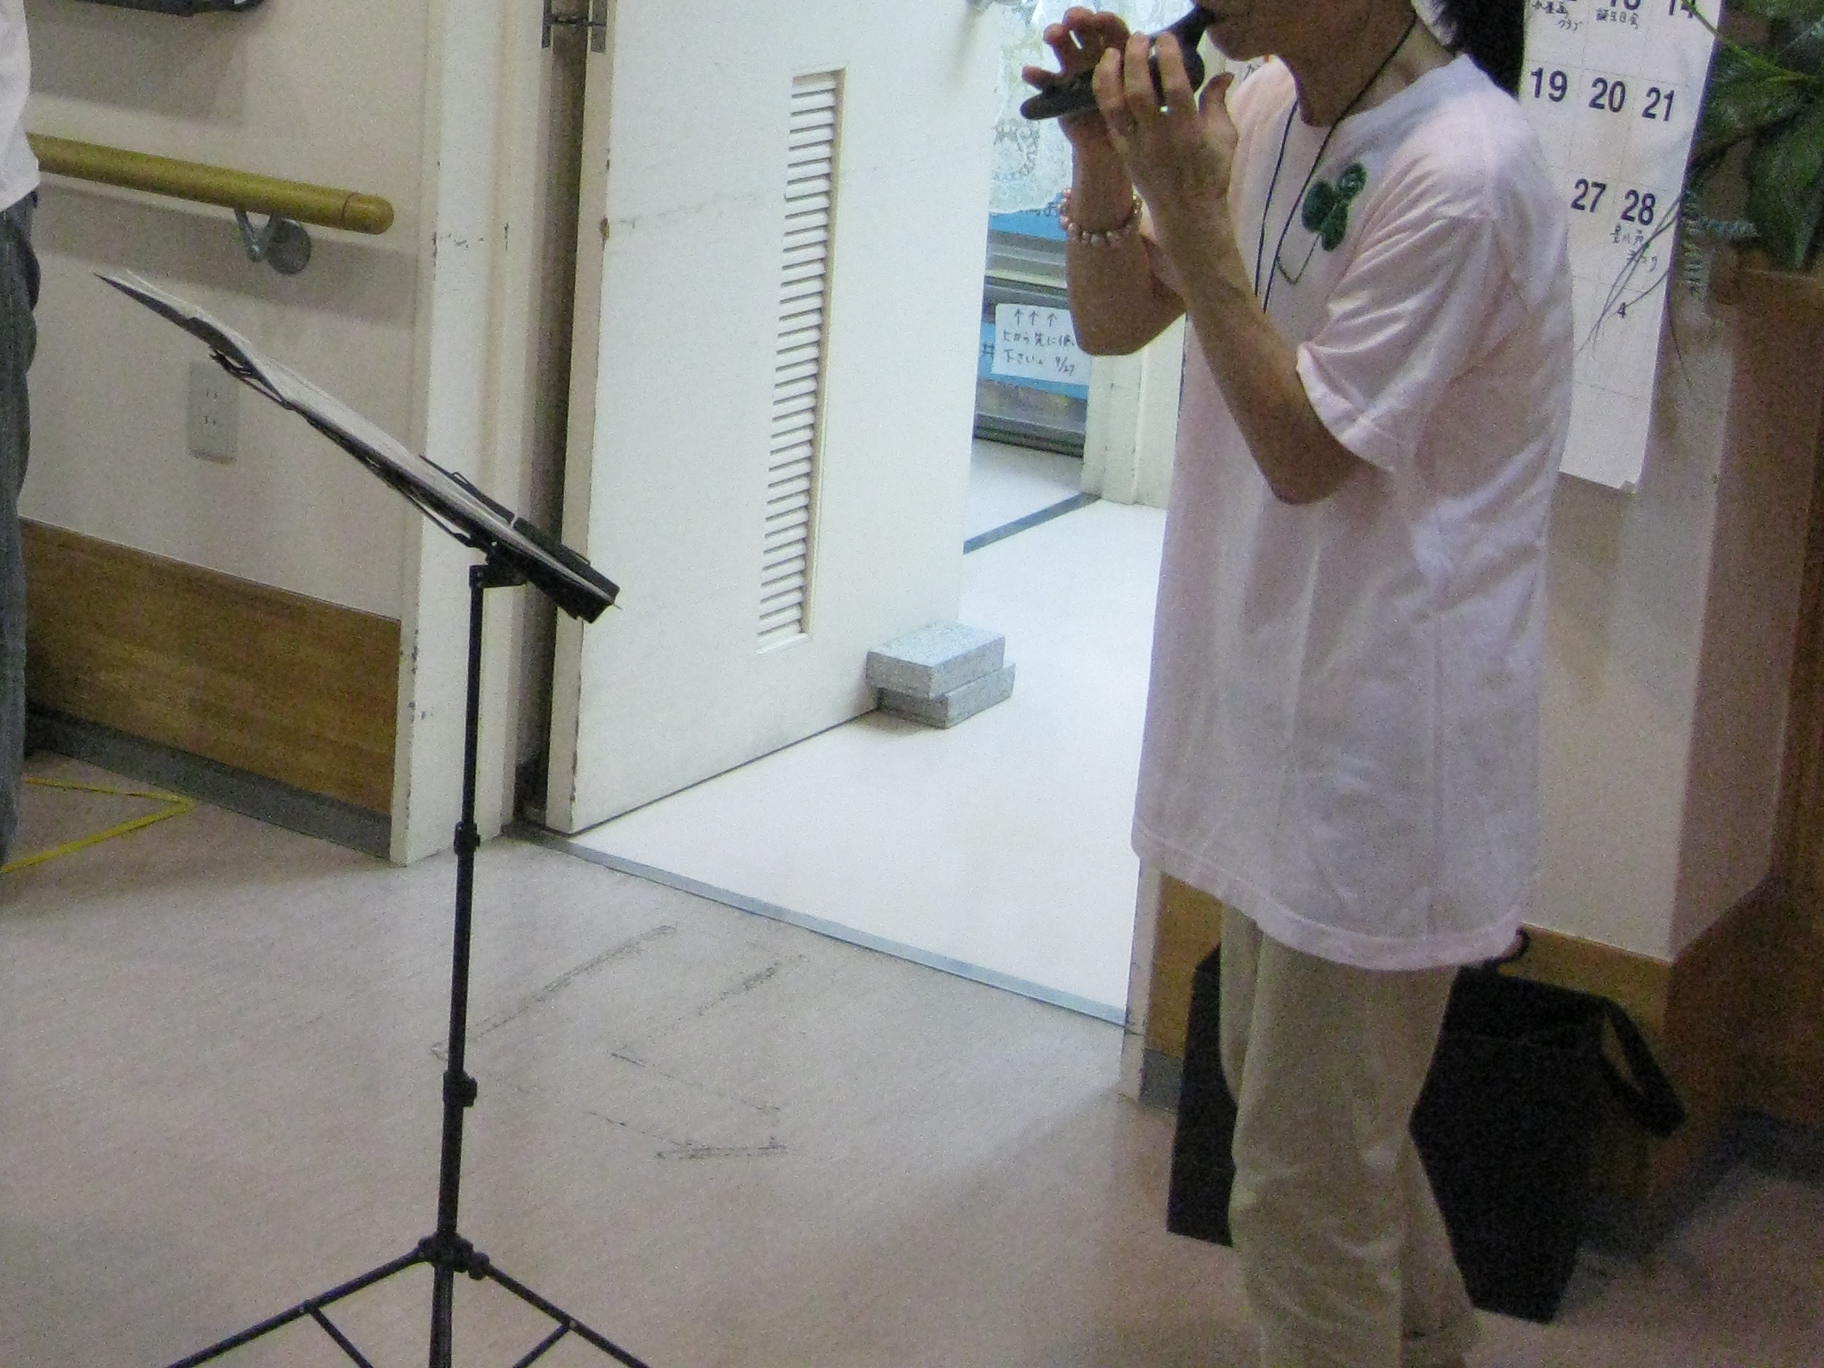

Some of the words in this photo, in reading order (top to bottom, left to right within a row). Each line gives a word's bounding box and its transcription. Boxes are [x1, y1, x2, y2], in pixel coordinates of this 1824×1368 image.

[1530, 66, 1568, 103] 19
[1588, 77, 1626, 113] 20
[1642, 86, 1676, 123] 21
[1570, 178, 1607, 214] 27
[1620, 189, 1657, 227] 28
[1616, 302, 1627, 319] 4
